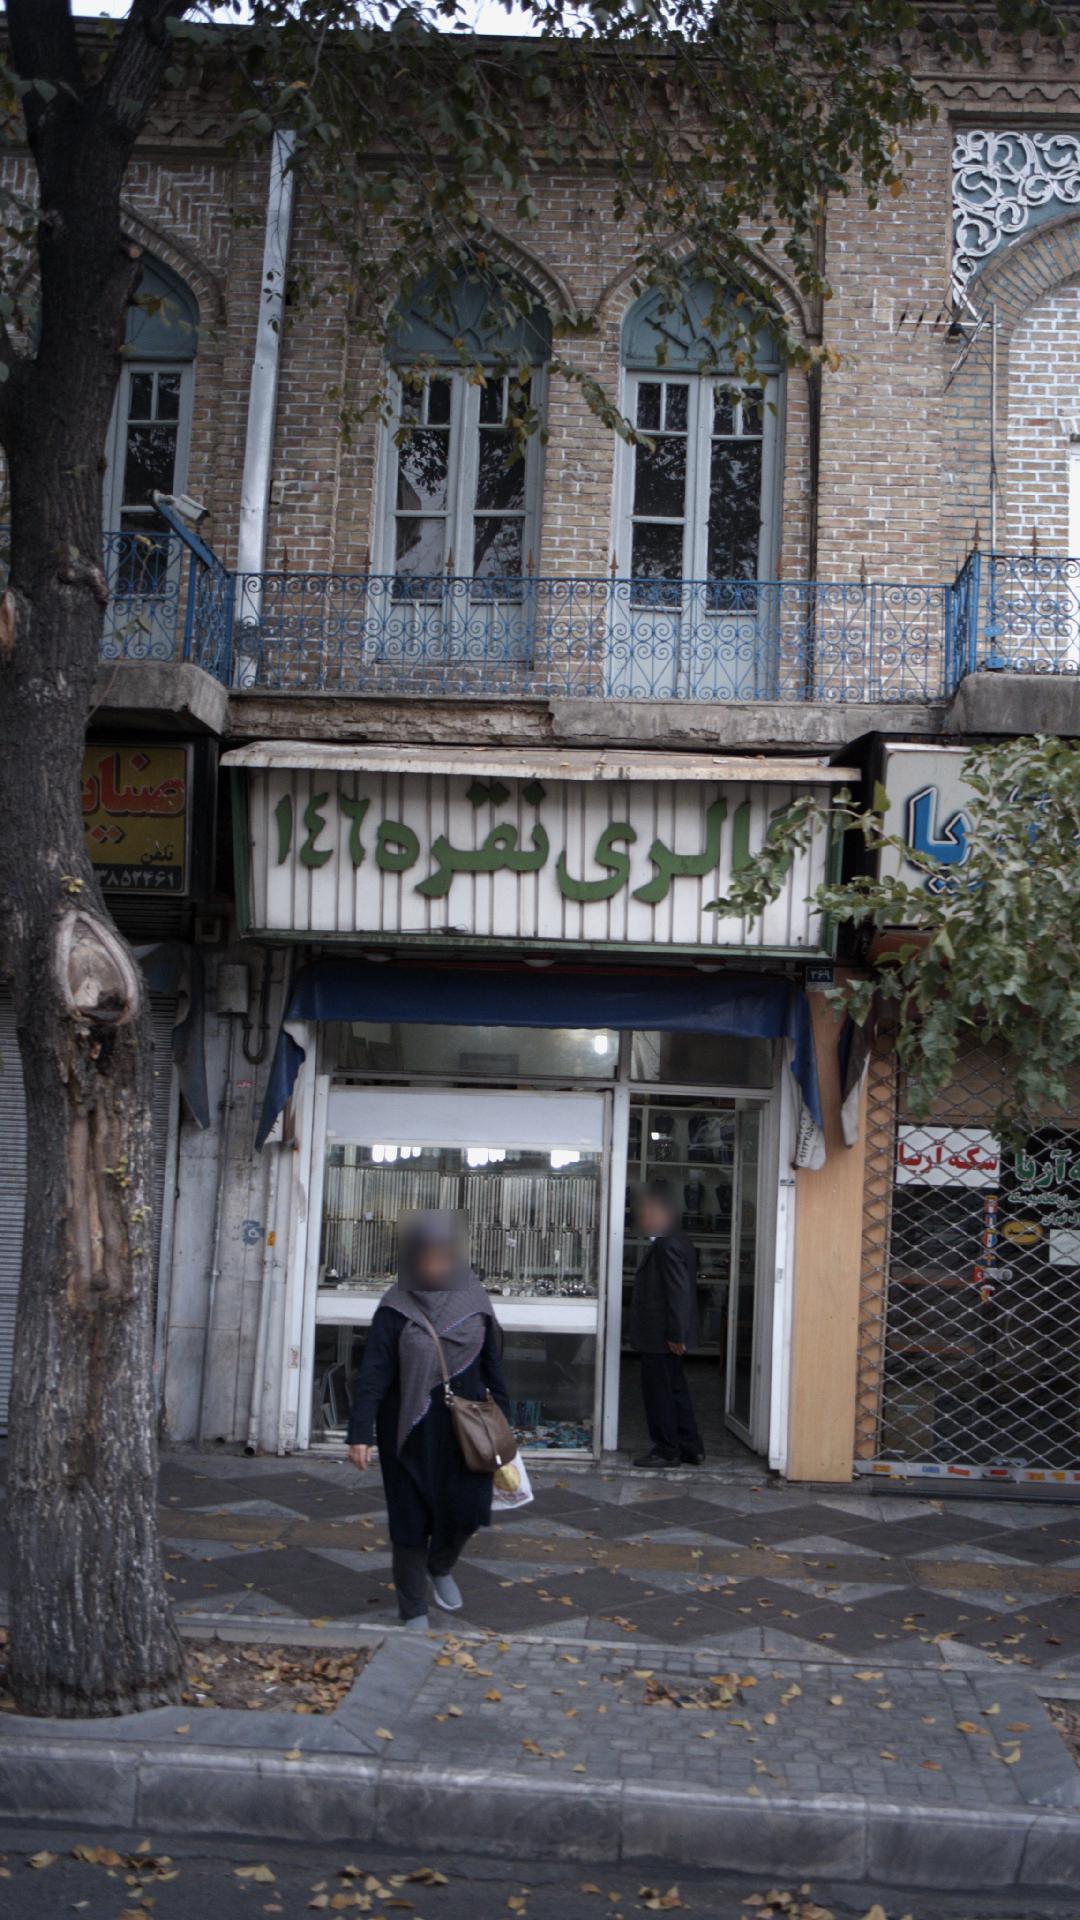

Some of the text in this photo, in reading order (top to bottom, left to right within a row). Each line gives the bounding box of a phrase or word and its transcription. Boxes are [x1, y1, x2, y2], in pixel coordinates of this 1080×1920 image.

[140, 843, 174, 865] تلفن
[374, 780, 551, 899] نقره
[898, 1139, 998, 1174] سکه آریا
[1014, 1148, 1073, 1191] آریا
